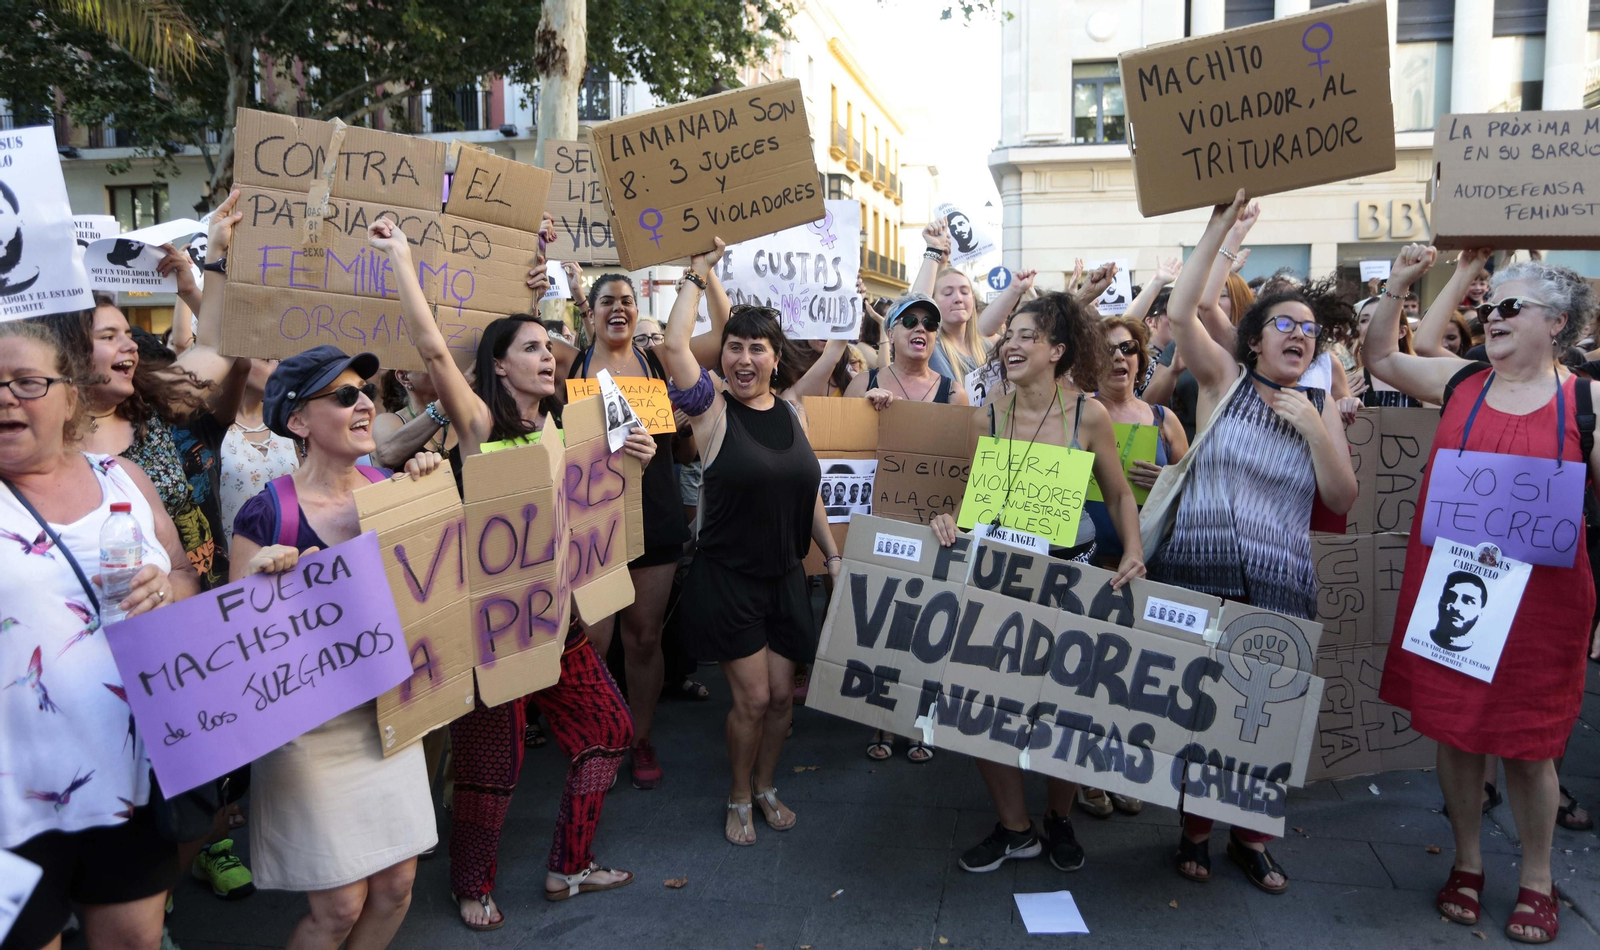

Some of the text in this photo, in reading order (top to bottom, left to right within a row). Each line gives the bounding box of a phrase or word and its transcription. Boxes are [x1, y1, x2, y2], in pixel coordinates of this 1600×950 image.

[1322, 72, 1358, 102] AL
[748, 97, 797, 123] SON
[1449, 117, 1473, 141] LA
[669, 158, 689, 185] 3
[699, 136, 780, 172] JUECES
[1463, 146, 1489, 161] EN
[1499, 145, 1520, 161] SU
[466, 167, 512, 208] EL
[714, 175, 726, 194] Y
[1453, 181, 1586, 199] AUTODEFENSA
[681, 208, 700, 232] 5
[94, 276, 121, 284] ESTADO
[131, 277, 163, 285] PERMITE
[116, 269, 150, 277] VIOLADOR
[753, 249, 842, 292] GUSTAS
[0, 287, 84, 306] ADOR Y EL ESTADO
[3, 302, 46, 316] PERMITE
[781, 294, 801, 324] NO
[808, 294, 858, 332] CALLAS
[882, 455, 906, 474] SI
[980, 451, 1060, 479] FUERA
[972, 473, 1083, 510] VIOLADORES
[1456, 465, 1564, 503] YO SÍ
[880, 491, 889, 502] A
[895, 491, 918, 506] LA
[974, 493, 1071, 522] DE NUESTRAS
[1008, 532, 1037, 547] ANGEL
[932, 536, 1136, 628] FUERA
[1453, 558, 1500, 580] CABEZUELO
[216, 554, 352, 623] FUERA
[1410, 636, 1491, 671] SOY UN VIOLADOR Y EL ESTADO
[1430, 651, 1464, 668] LO PERMITE
[242, 622, 395, 713] JUZGADOS
[840, 658, 1293, 818] DE NUESTRAS CALLES
